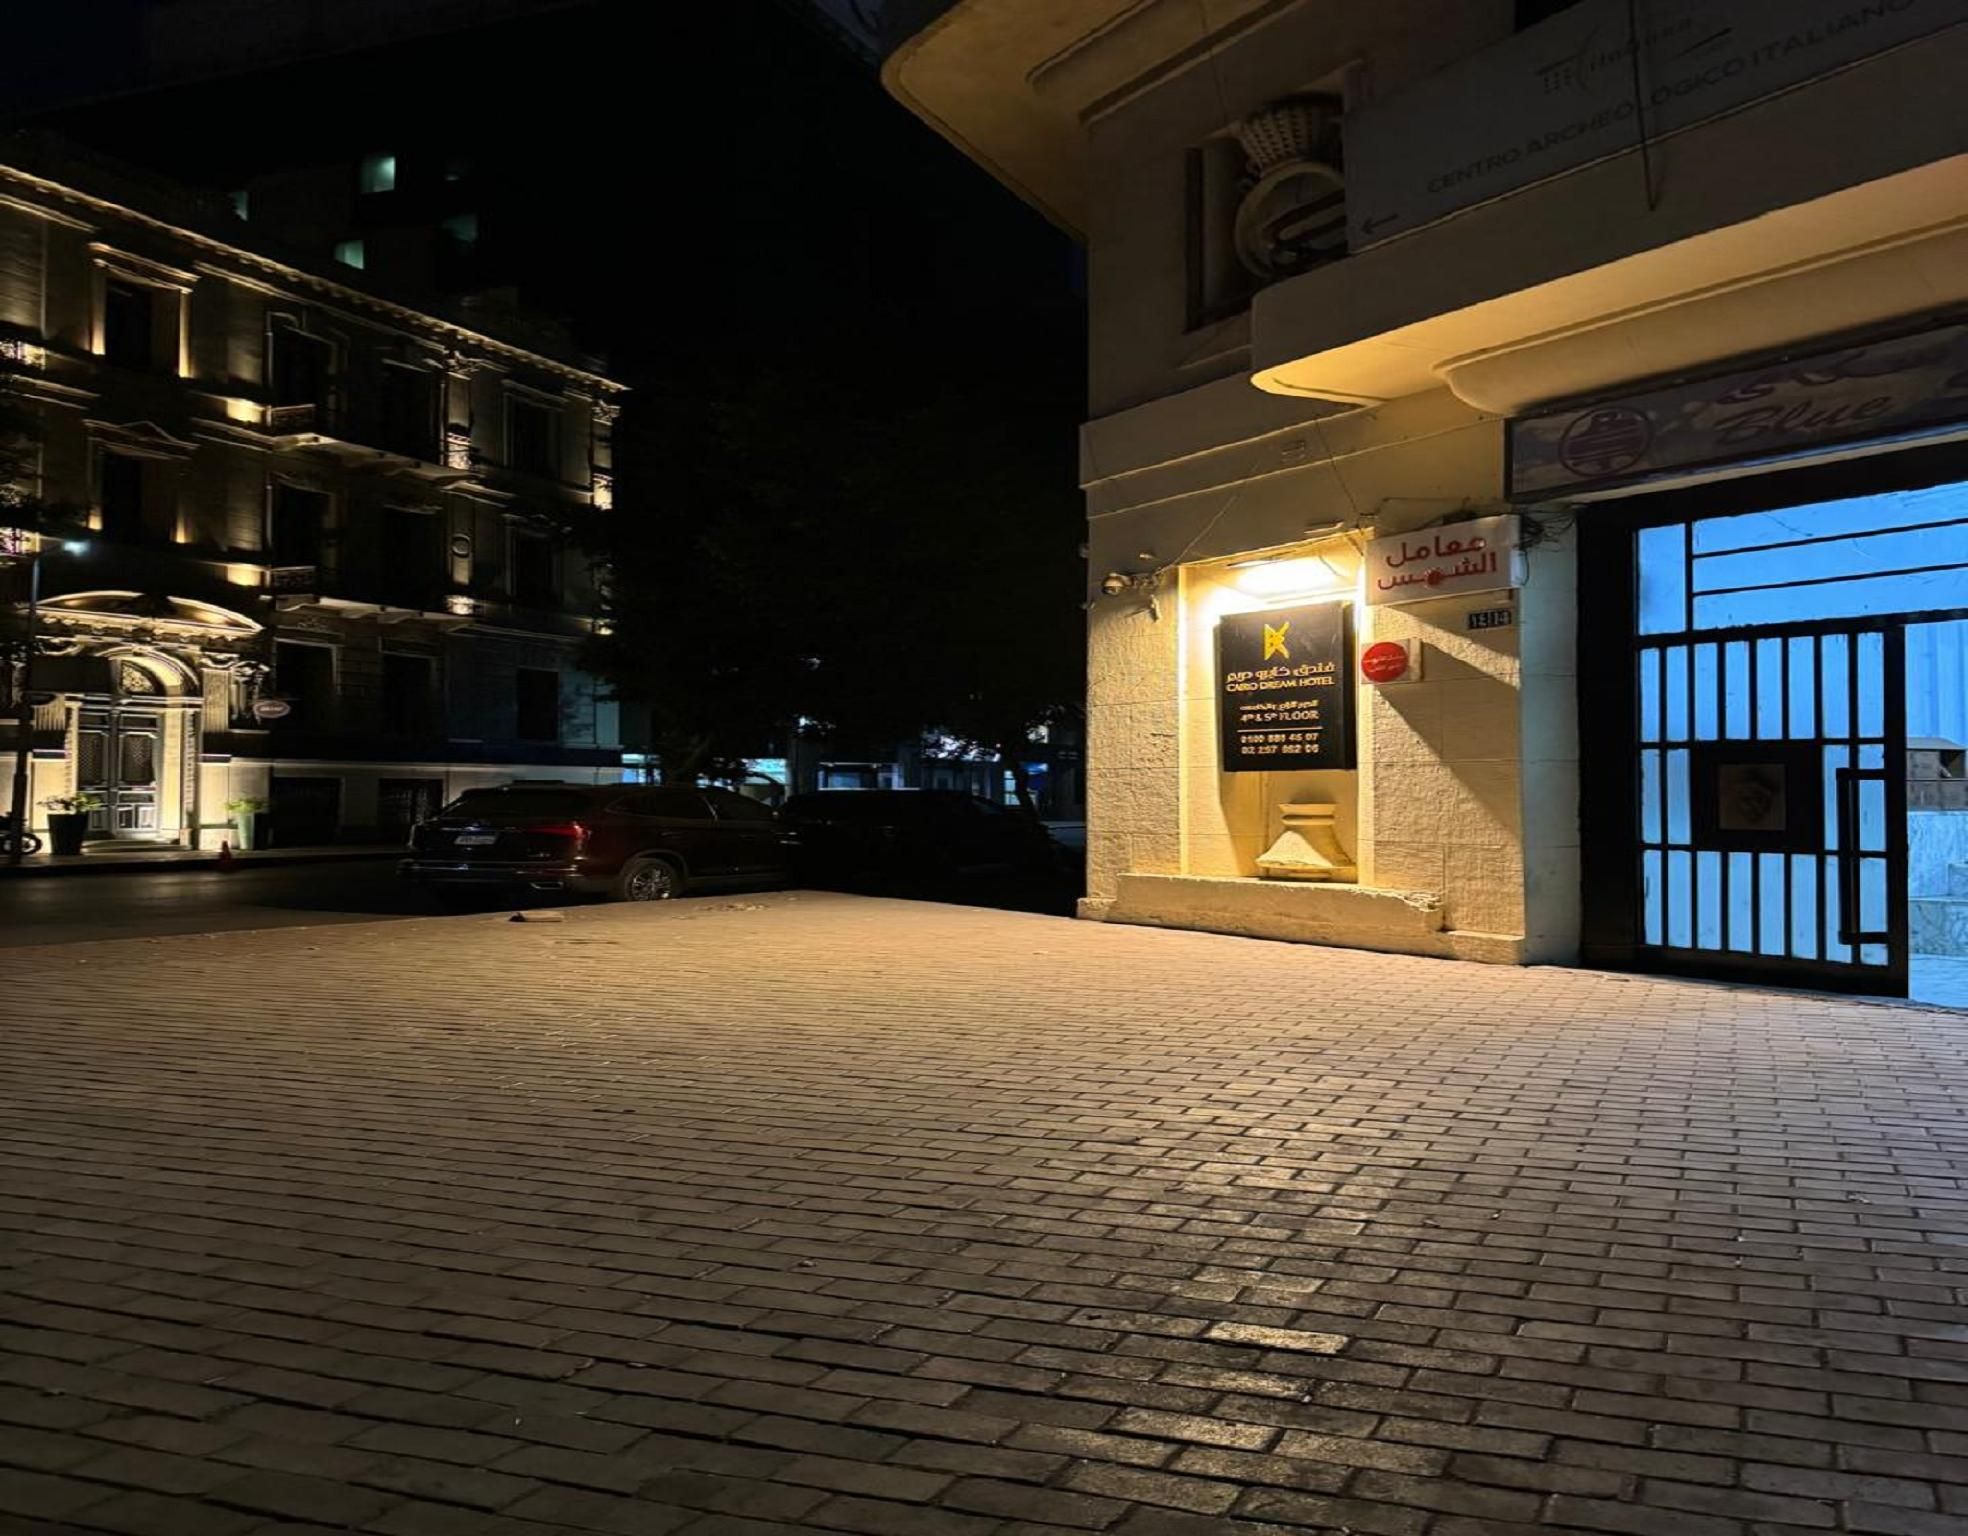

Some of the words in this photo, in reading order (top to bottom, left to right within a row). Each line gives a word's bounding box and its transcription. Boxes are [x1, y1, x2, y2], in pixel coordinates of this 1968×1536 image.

[1427, 148, 1522, 194] CENTRO
[1713, 394, 1893, 446] Blue
[1385, 535, 1488, 568] معامل
[1377, 552, 1497, 591] الشمس
[1226, 681, 1258, 692] CAIRO
[1259, 678, 1297, 690] DREAM
[1299, 676, 1336, 687] HOTEL
[1293, 661, 1336, 677] فندق
[1279, 710, 1320, 721] FLOOR
